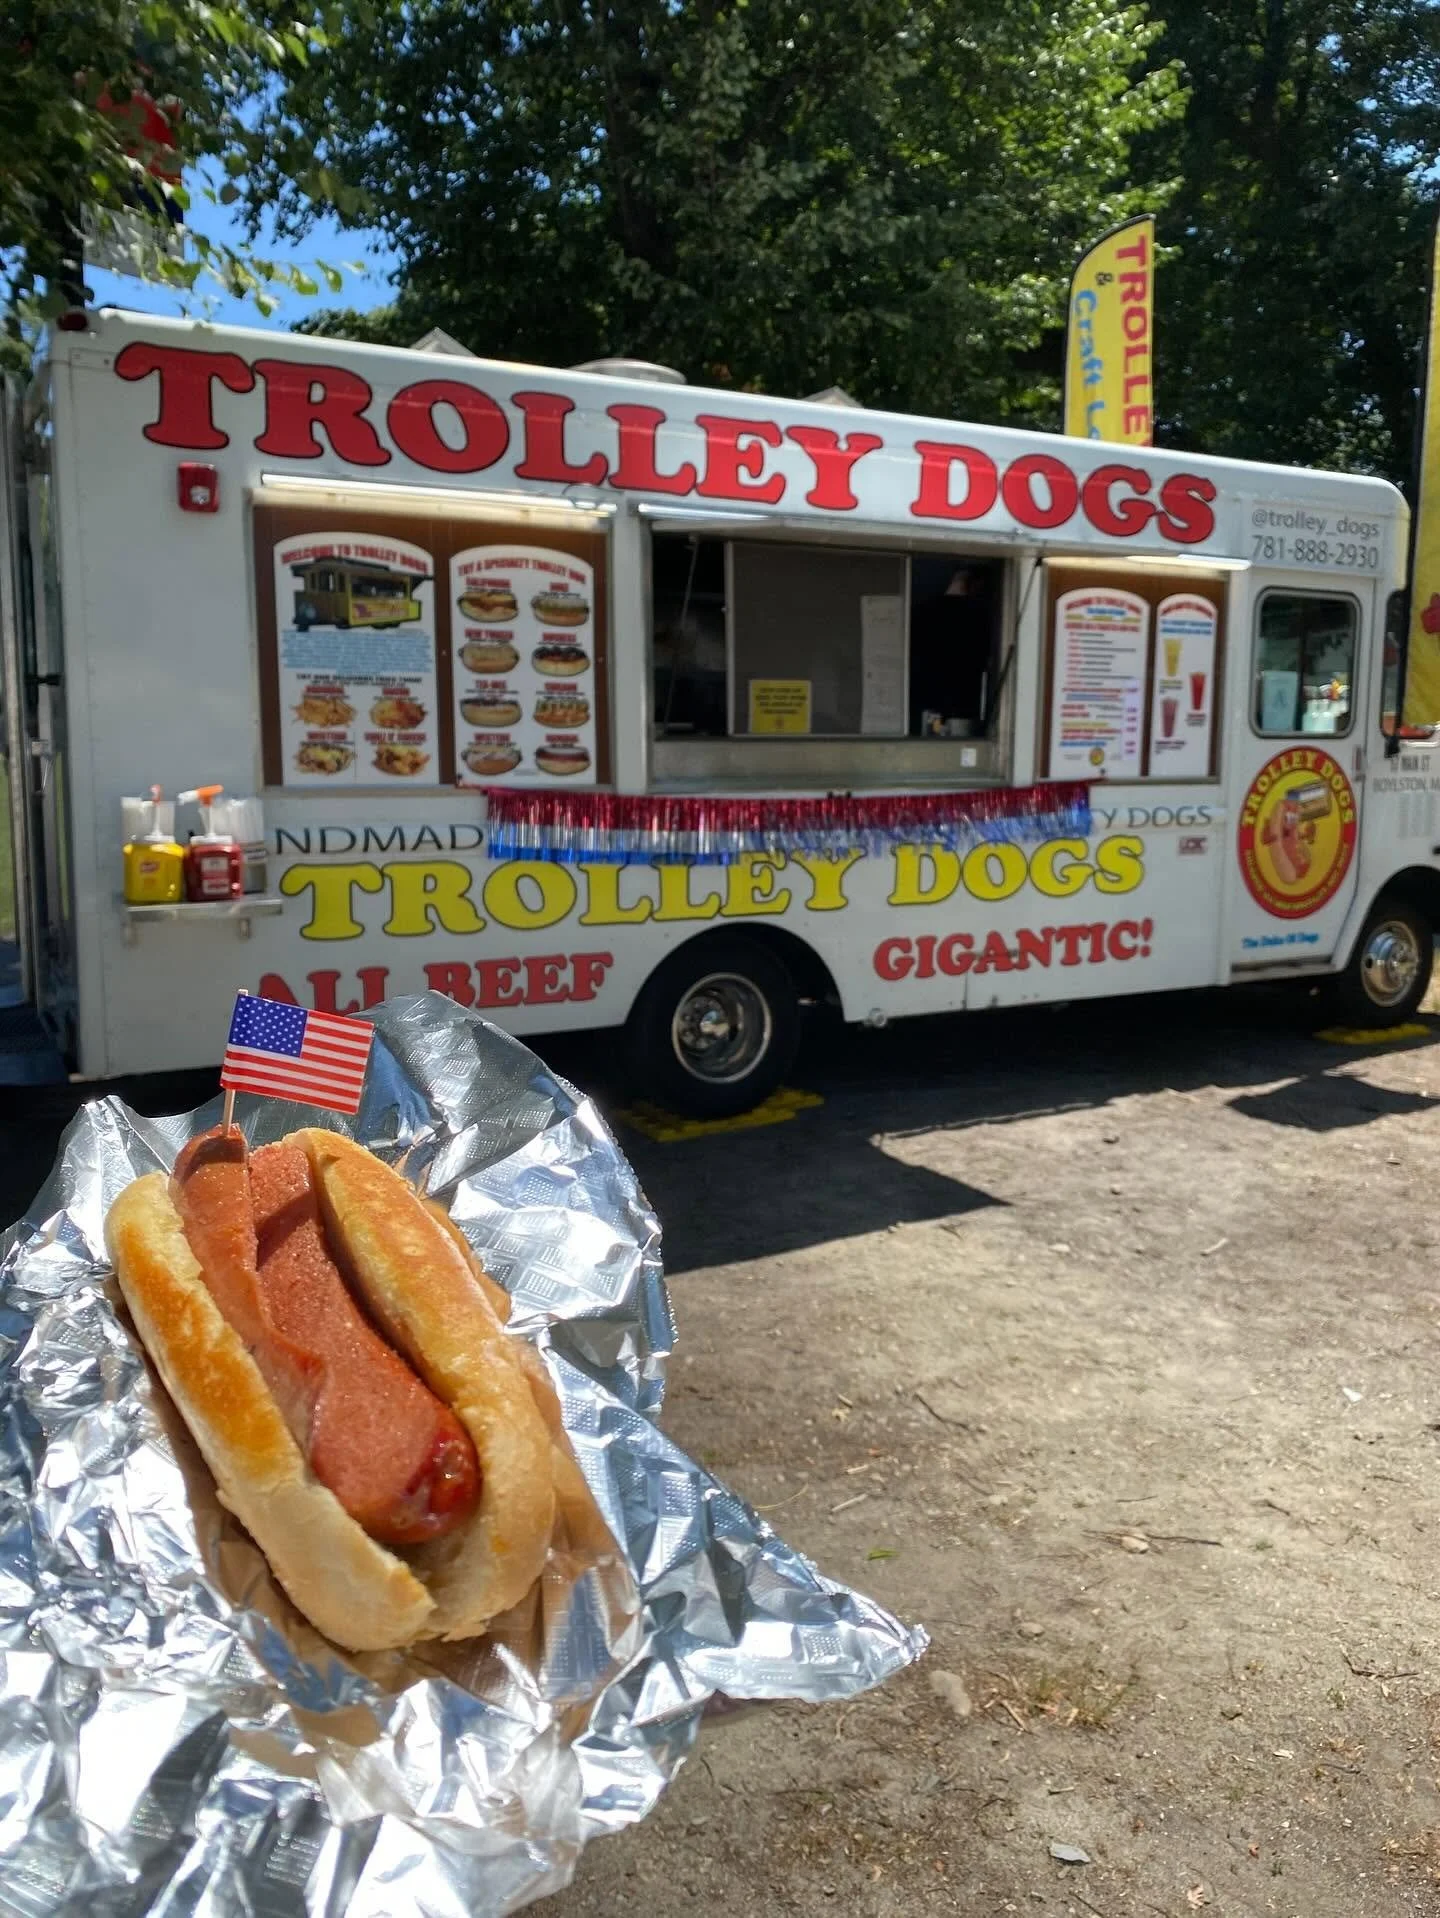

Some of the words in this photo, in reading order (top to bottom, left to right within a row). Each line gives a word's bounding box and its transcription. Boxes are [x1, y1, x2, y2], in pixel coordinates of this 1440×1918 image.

[1116, 234, 1152, 446] TROLLE
[115, 341, 883, 510] TROLLEY
[910, 440, 1217, 544] DOGS
[1251, 507, 1379, 540] @trolley_dogs
[1251, 533, 1379, 569] 781-888-2930
[1127, 805, 1212, 829] DOGS
[1243, 750, 1317, 825] TROLLEY
[1319, 761, 1354, 823] DOGS
[280, 846, 866, 941] TROLLEY
[888, 835, 1145, 905] DOGS
[423, 952, 614, 1009] BEEF
[873, 917, 1154, 982] GIGANTIC!
